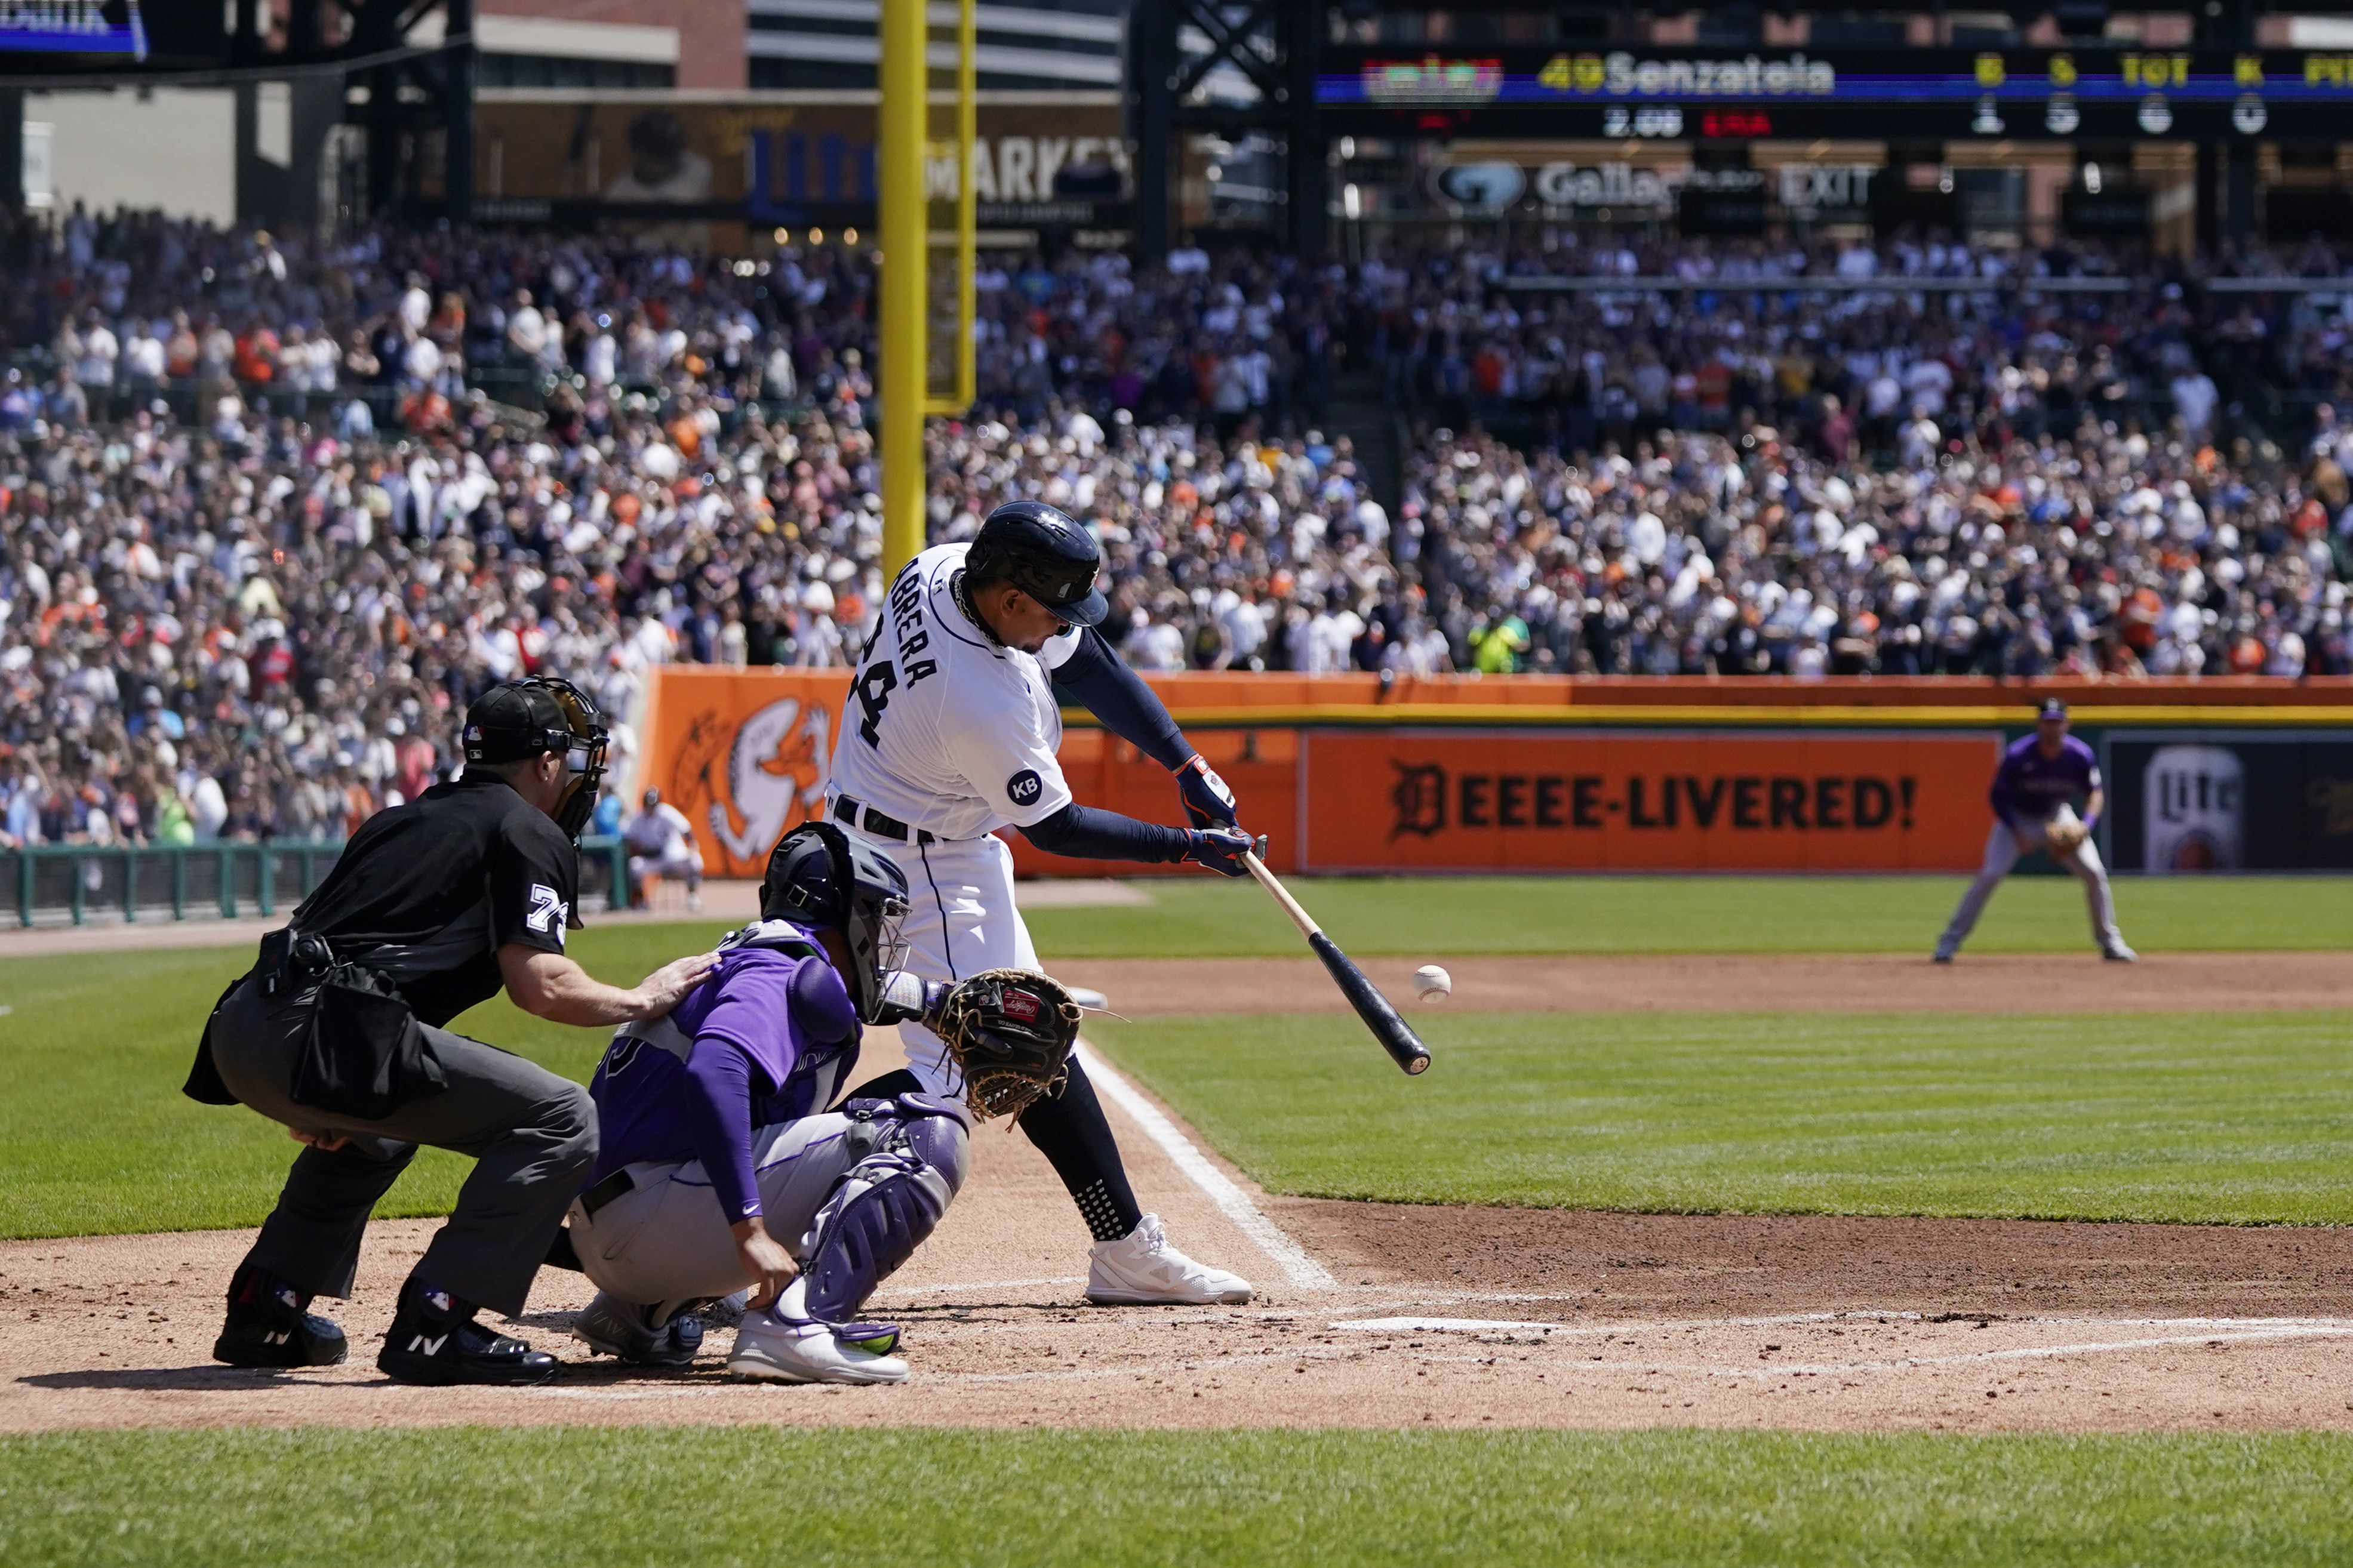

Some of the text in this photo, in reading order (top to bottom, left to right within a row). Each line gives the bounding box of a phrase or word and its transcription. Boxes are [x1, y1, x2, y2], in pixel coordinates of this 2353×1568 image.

[1537, 53, 1605, 94] 49
[1779, 163, 1878, 207] EXIT
[1011, 777, 1039, 800] KB
[1388, 756, 1918, 845] DEEEE-LIVERED!
[1005, 1000, 1035, 1014] Rawlings
[407, 1333, 449, 1357] N
